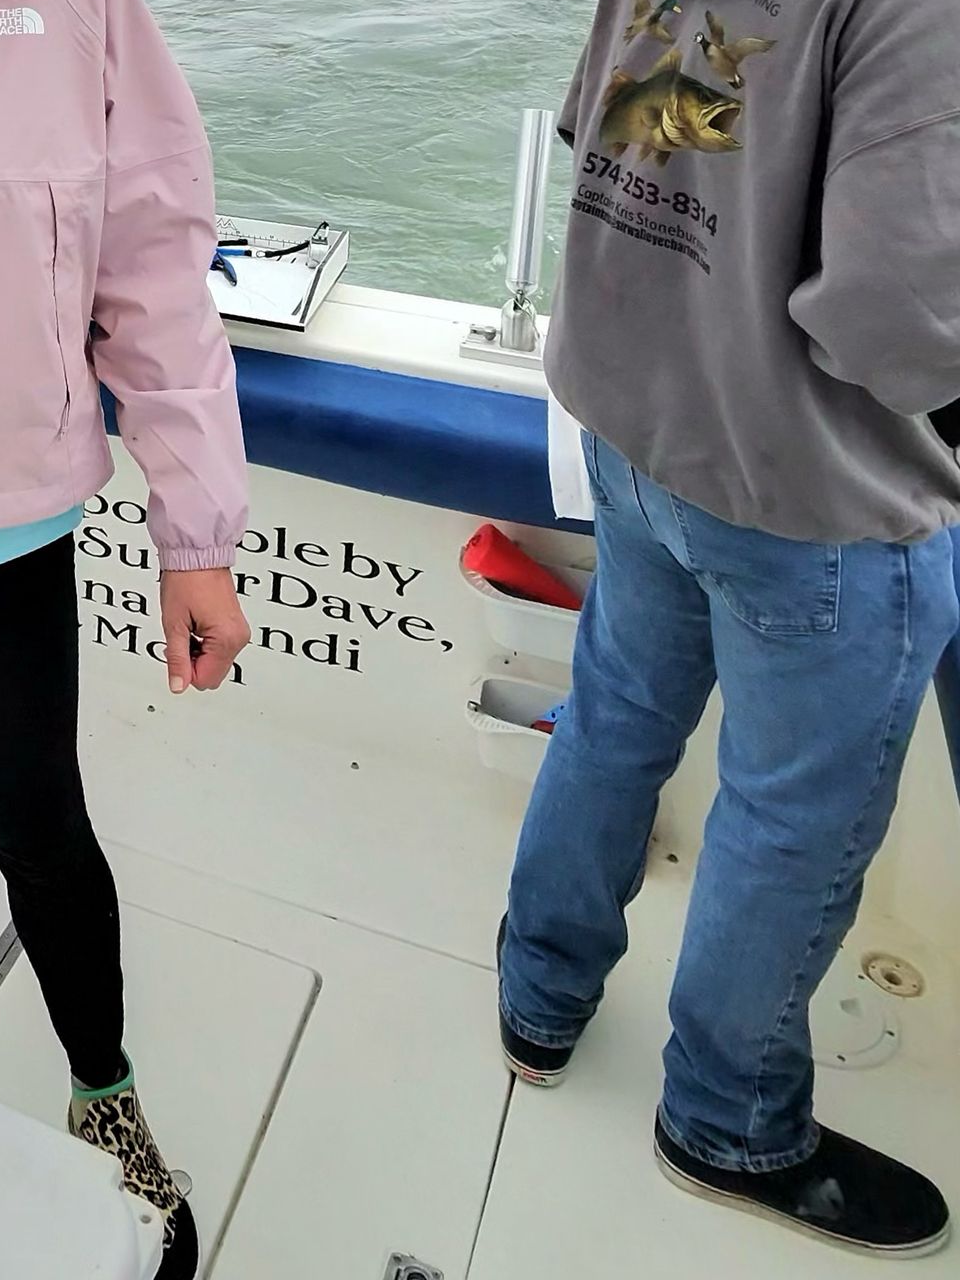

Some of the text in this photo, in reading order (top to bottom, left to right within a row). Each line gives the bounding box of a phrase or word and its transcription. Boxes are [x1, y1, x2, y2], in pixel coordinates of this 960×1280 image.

[0, 7, 23, 18] THE
[582, 152, 719, 237] 574-253-8314
[614, 200, 634, 222] Kris
[341, 541, 424, 597] by
[266, 569, 454, 654] Dave,
